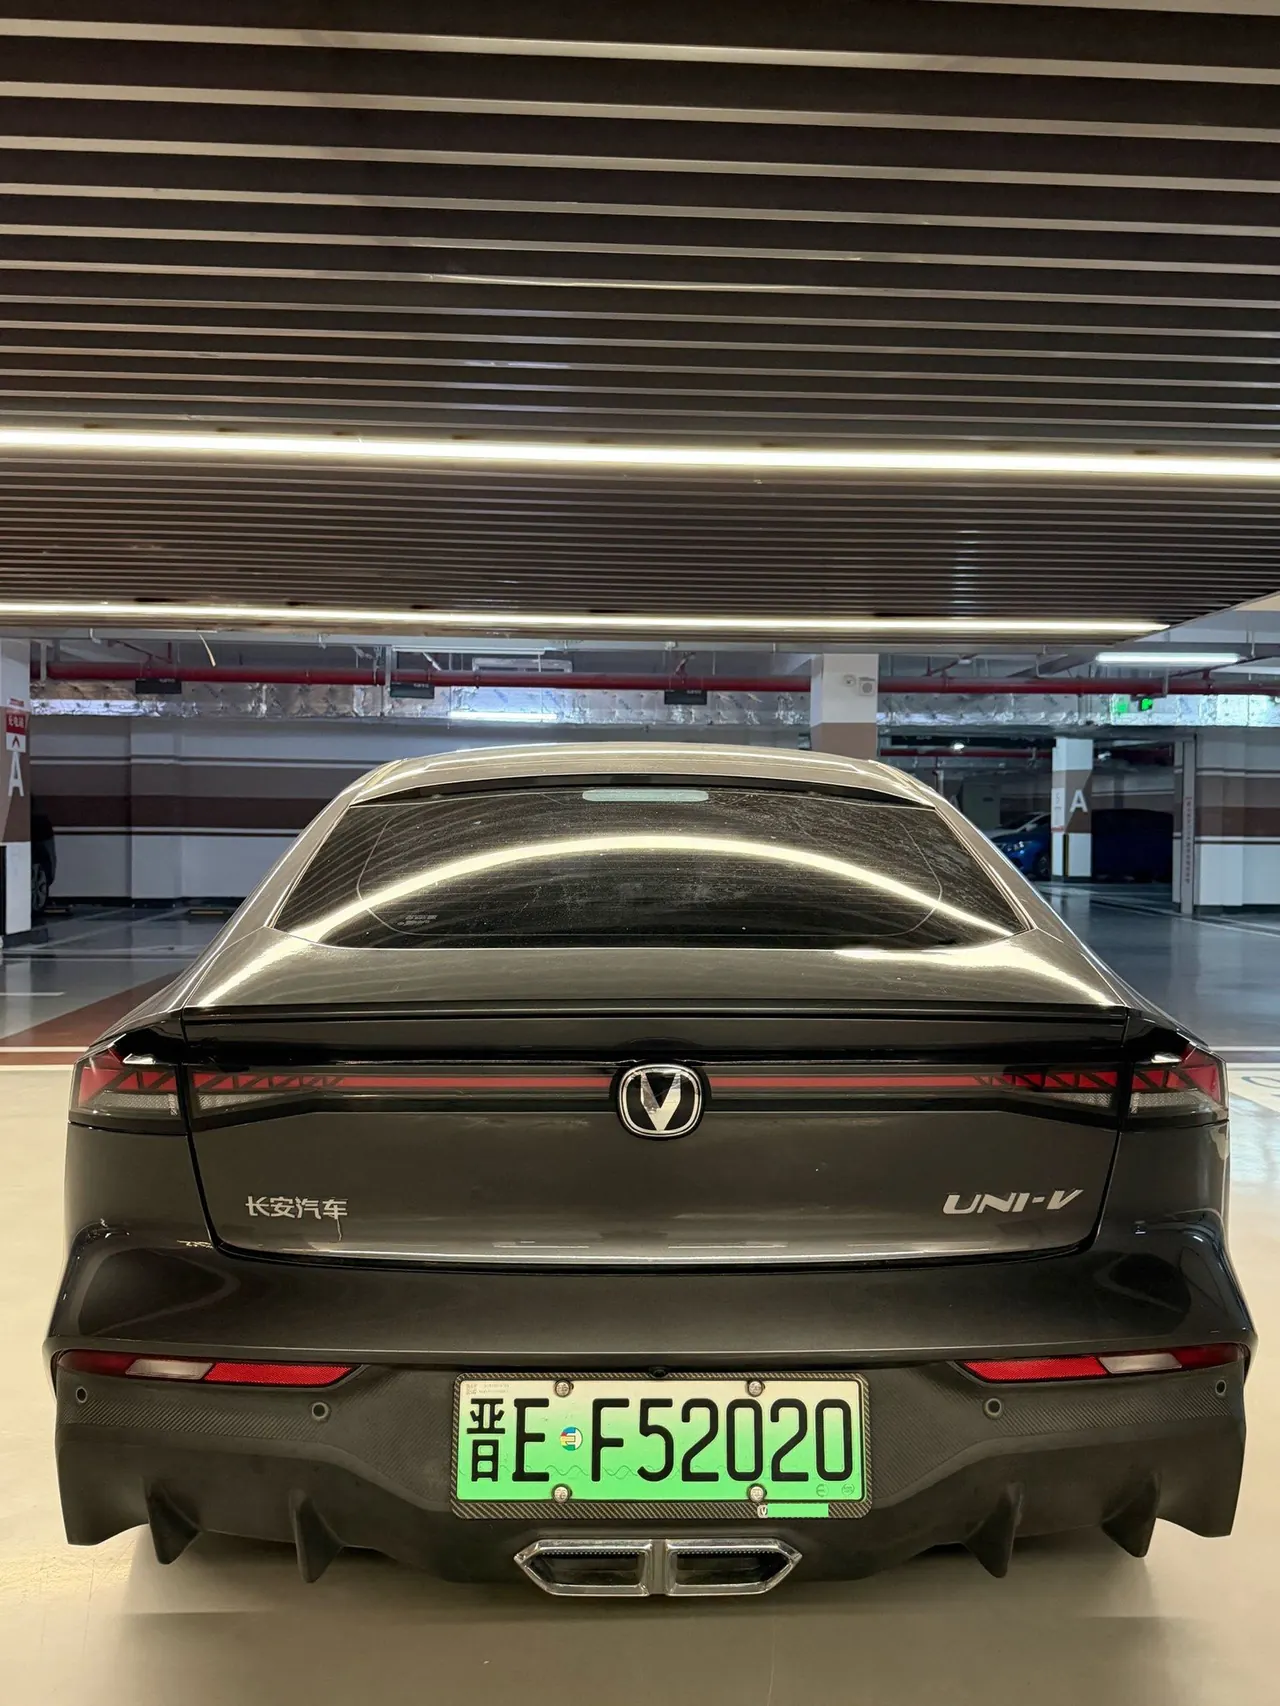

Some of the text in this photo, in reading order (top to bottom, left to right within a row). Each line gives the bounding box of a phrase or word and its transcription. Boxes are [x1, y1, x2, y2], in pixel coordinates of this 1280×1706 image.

[8, 751, 24, 797] A
[1070, 789, 1088, 813] A
[245, 1196, 348, 1220] 长安汽车
[942, 1189, 1084, 1215] UNI-V
